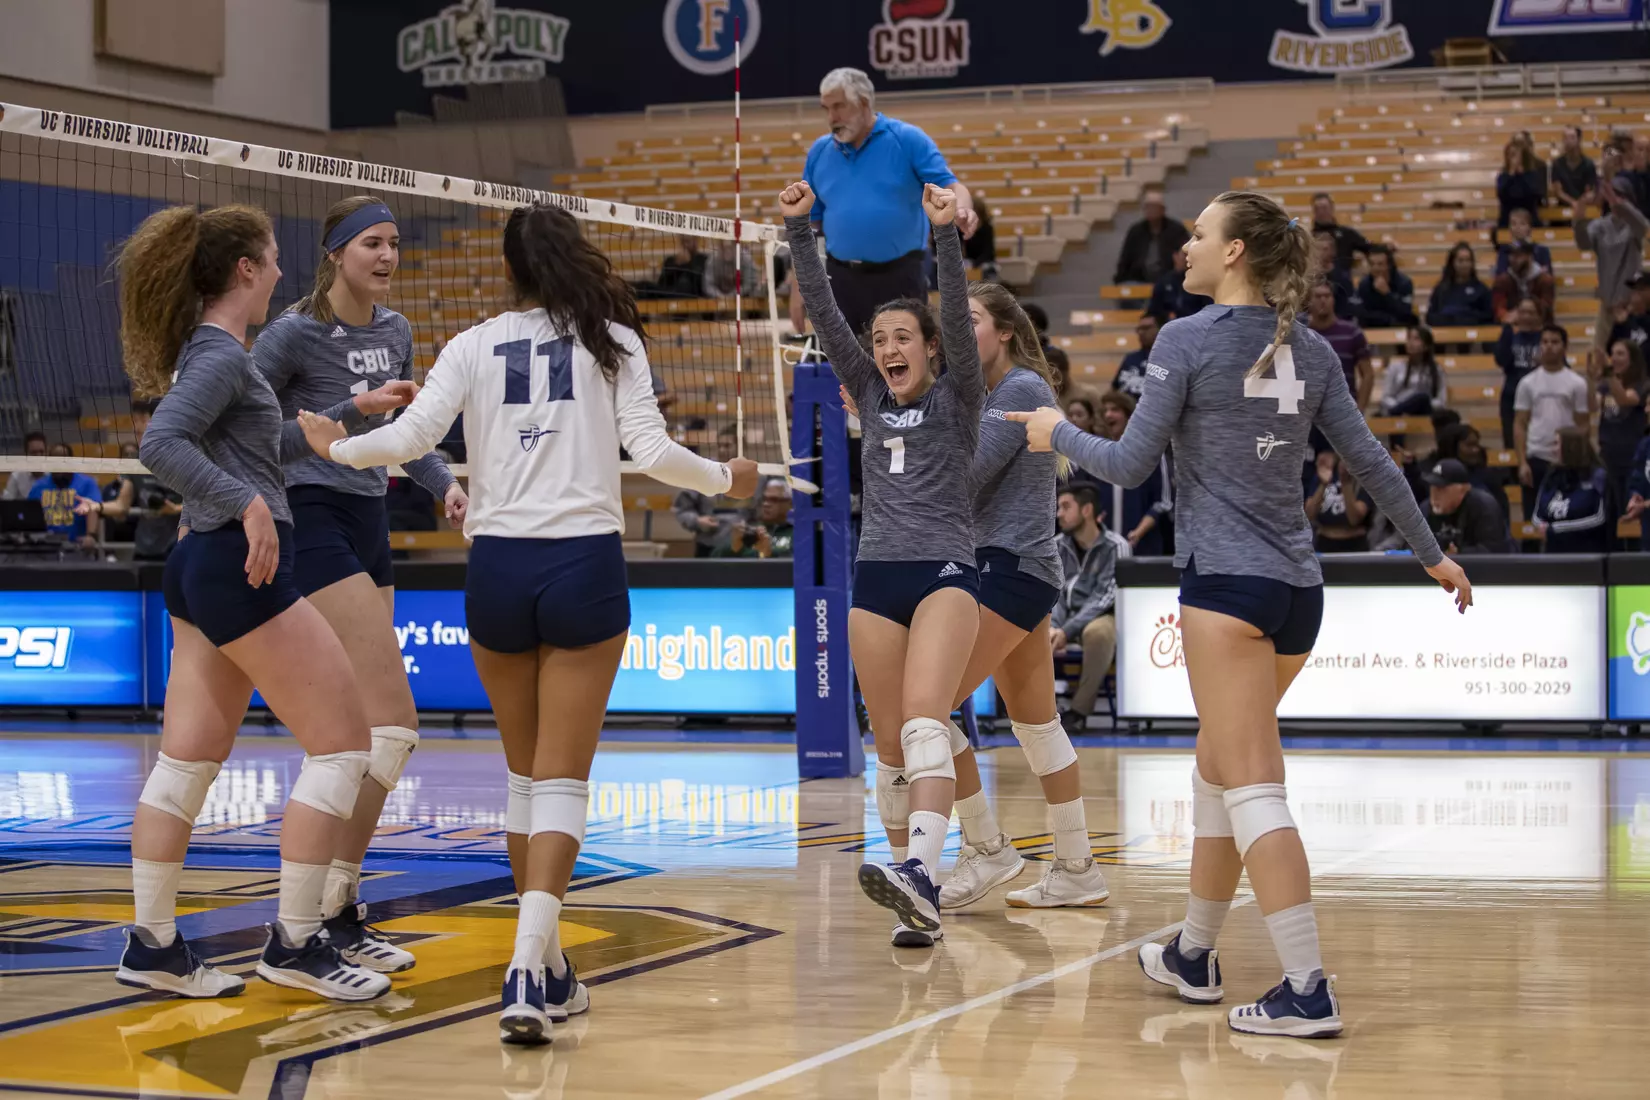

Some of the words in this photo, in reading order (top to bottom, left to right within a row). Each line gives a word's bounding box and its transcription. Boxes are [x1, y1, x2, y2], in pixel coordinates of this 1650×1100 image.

[403, 18, 455, 66] CAL
[496, 13, 563, 54] POLY
[873, 23, 964, 65] CSUN
[1276, 32, 1407, 67] RIVERSIDE
[40, 110, 58, 132] UC
[63, 114, 132, 144] RIVERSIDE
[137, 126, 210, 157] VOLLEYBALL
[278, 150, 293, 170] UC
[297, 153, 353, 179] RIVERSIDE
[357, 162, 416, 188] VOLLEYBALL
[474, 180, 487, 196] UC
[491, 183, 536, 204] RIVERSIDE
[635, 207, 646, 222] UC
[649, 209, 686, 229] RIVERSIDE
[347, 347, 391, 375] CBU
[493, 335, 576, 405] 11
[1243, 344, 1306, 415] 4
[883, 436, 905, 474] 1
[938, 569, 964, 578] adidas
[813, 599, 829, 643] sports
[1303, 653, 1366, 668] Central
[1371, 653, 1408, 668] Ave.
[1415, 653, 1426, 669] &
[1434, 652, 1516, 668] Riverside
[1522, 653, 1568, 668] Plaza
[1464, 681, 1571, 694] 951-300-2029
